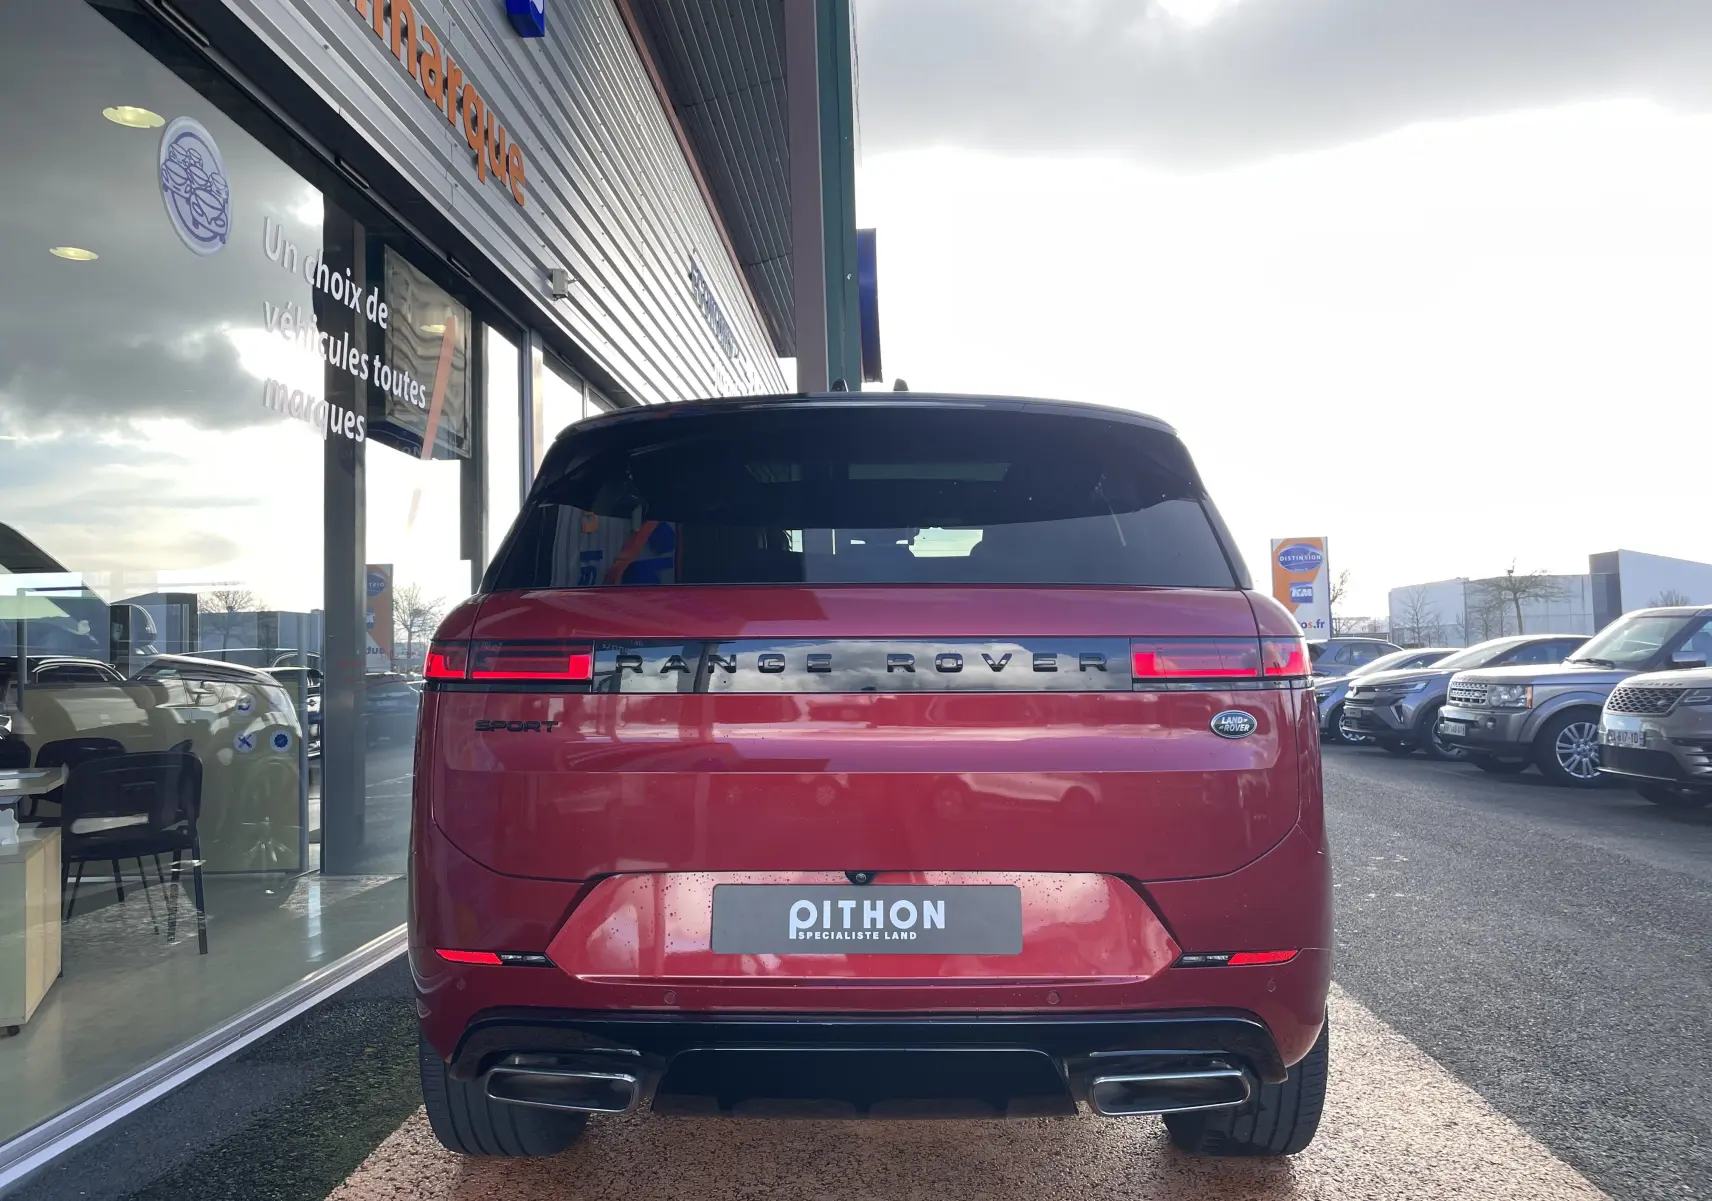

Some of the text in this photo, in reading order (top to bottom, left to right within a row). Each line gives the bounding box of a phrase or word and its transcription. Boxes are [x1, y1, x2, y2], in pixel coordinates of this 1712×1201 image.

[355, 0, 526, 207] marque
[264, 216, 389, 329] Un choix de
[264, 301, 427, 409] véhicules toutes
[263, 376, 365, 442] marques
[1280, 553, 1321, 562] DISTINXION
[1300, 619, 1325, 629] os.fr
[615, 653, 1108, 674] RANGE ROVER
[474, 719, 559, 732] SPORT
[1221, 716, 1243, 724] LAND
[1224, 724, 1250, 732] ROVER
[789, 899, 945, 939] PITHON
[798, 931, 917, 940] SPECIALISTE LAND
